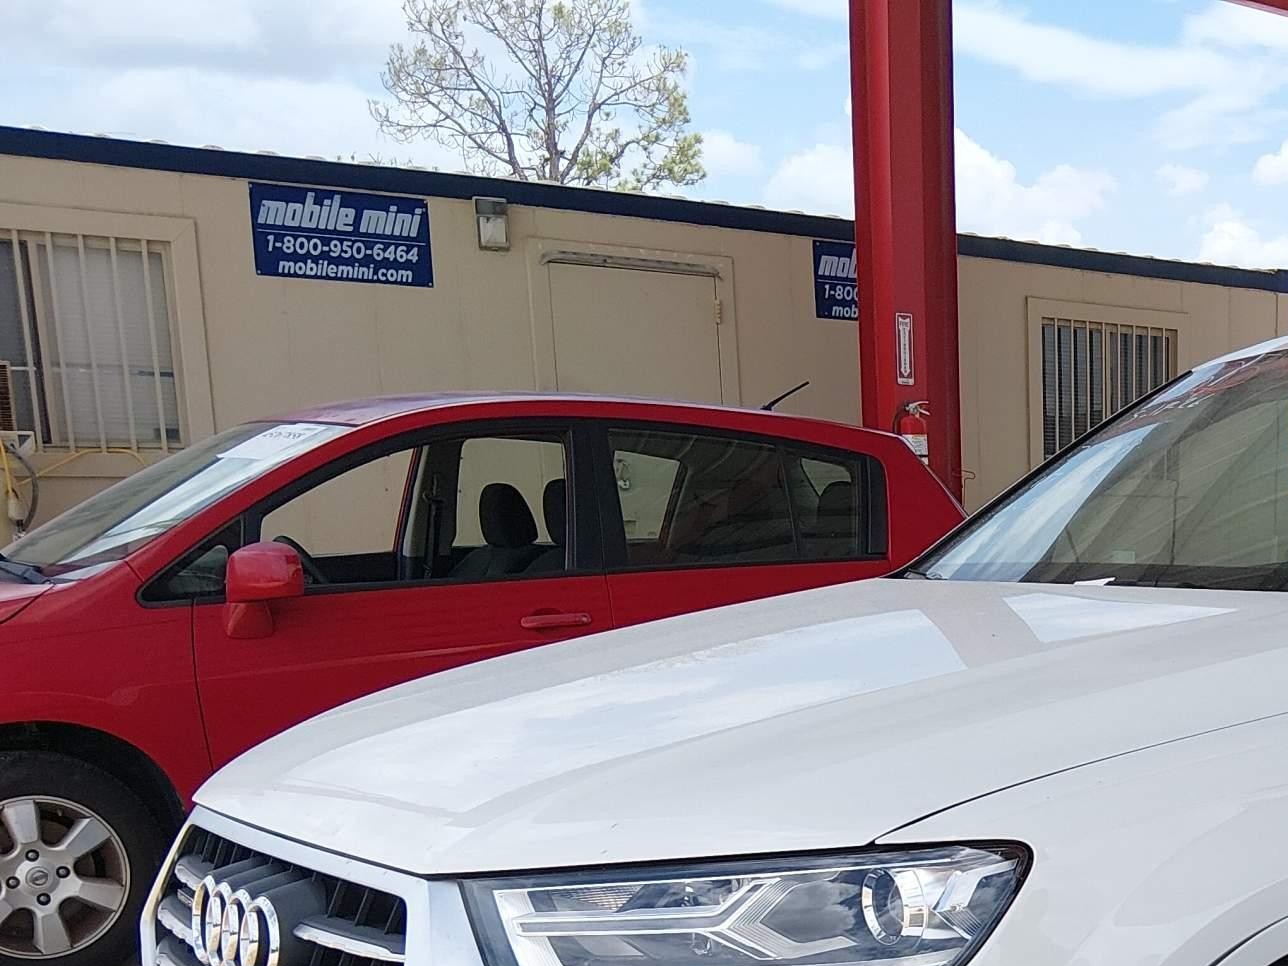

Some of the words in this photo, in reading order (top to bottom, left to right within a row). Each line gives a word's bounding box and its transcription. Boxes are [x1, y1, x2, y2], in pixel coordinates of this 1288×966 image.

[257, 192, 356, 232] mobile
[359, 205, 423, 238] mini
[266, 234, 419, 264] 1-800-950-6464
[278, 259, 413, 283] mobilemini.com
